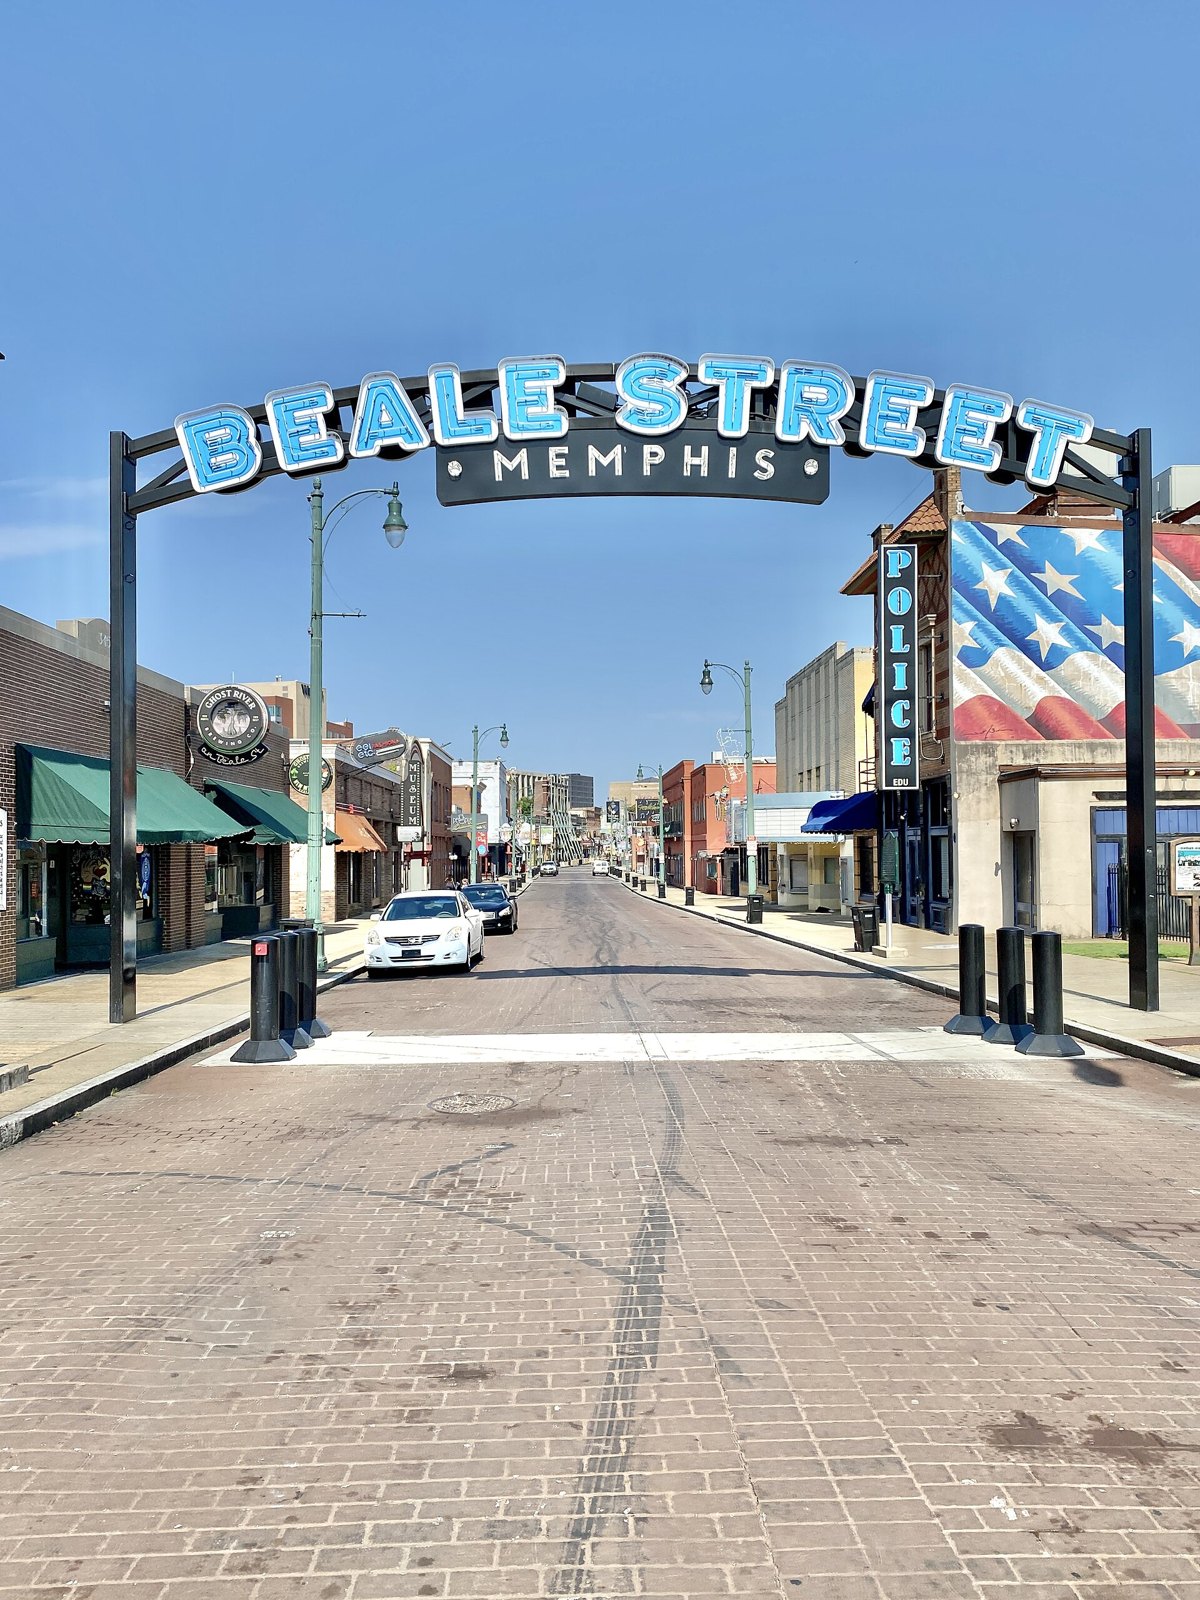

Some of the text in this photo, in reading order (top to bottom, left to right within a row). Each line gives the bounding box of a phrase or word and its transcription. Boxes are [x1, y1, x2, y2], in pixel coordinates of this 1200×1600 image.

[174, 352, 1095, 494] BEALE STREET
[492, 444, 776, 482] MEMPHIS
[886, 548, 913, 766] POLICE
[205, 689, 256, 710] GHOST RIVER
[204, 726, 257, 746] BREWING CO.
[408, 763, 418, 825] MUSEUM
[892, 778, 909, 787] EDU
